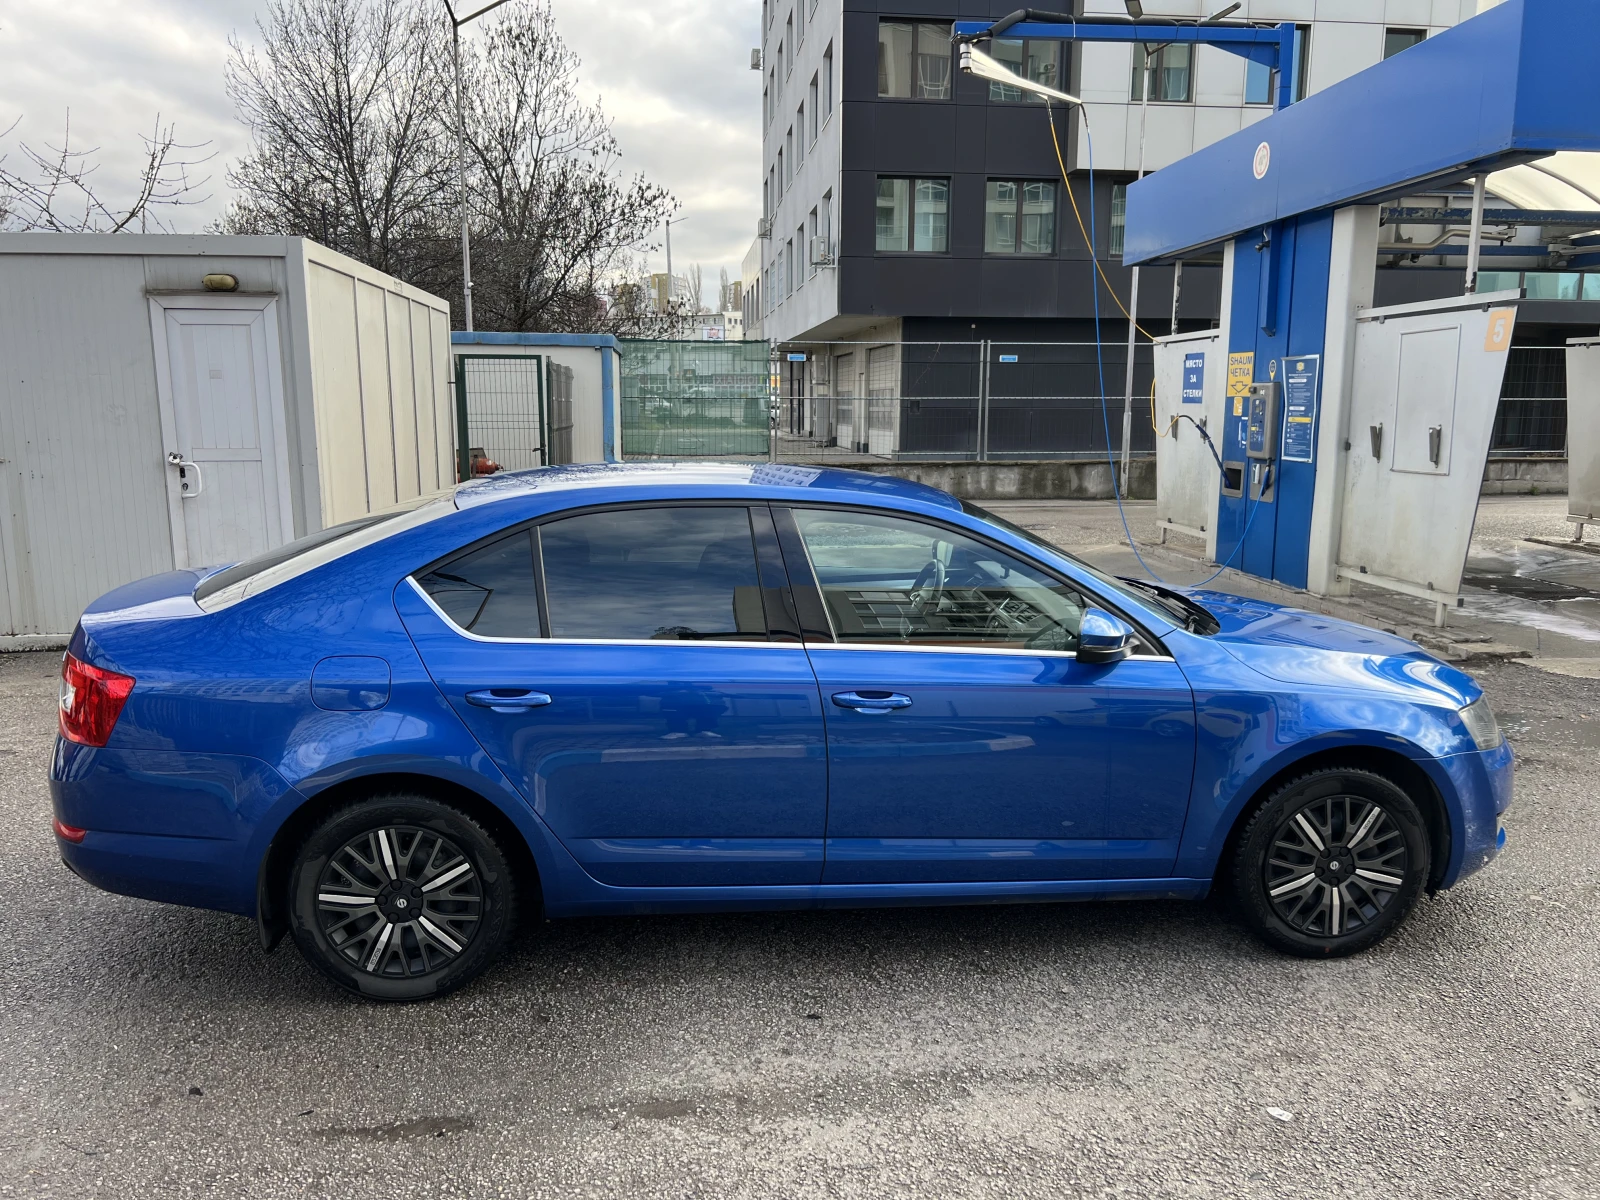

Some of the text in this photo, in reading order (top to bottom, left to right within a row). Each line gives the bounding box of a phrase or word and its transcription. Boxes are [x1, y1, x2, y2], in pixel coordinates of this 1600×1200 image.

[1492, 318, 1506, 344] 5
[1185, 359, 1203, 369] МЯСТО
[1230, 355, 1253, 366] SHAUM
[1230, 367, 1251, 377] ЧЕТКА
[1189, 374, 1197, 383] ЗА
[1183, 389, 1203, 398] СТЕЛКИ
